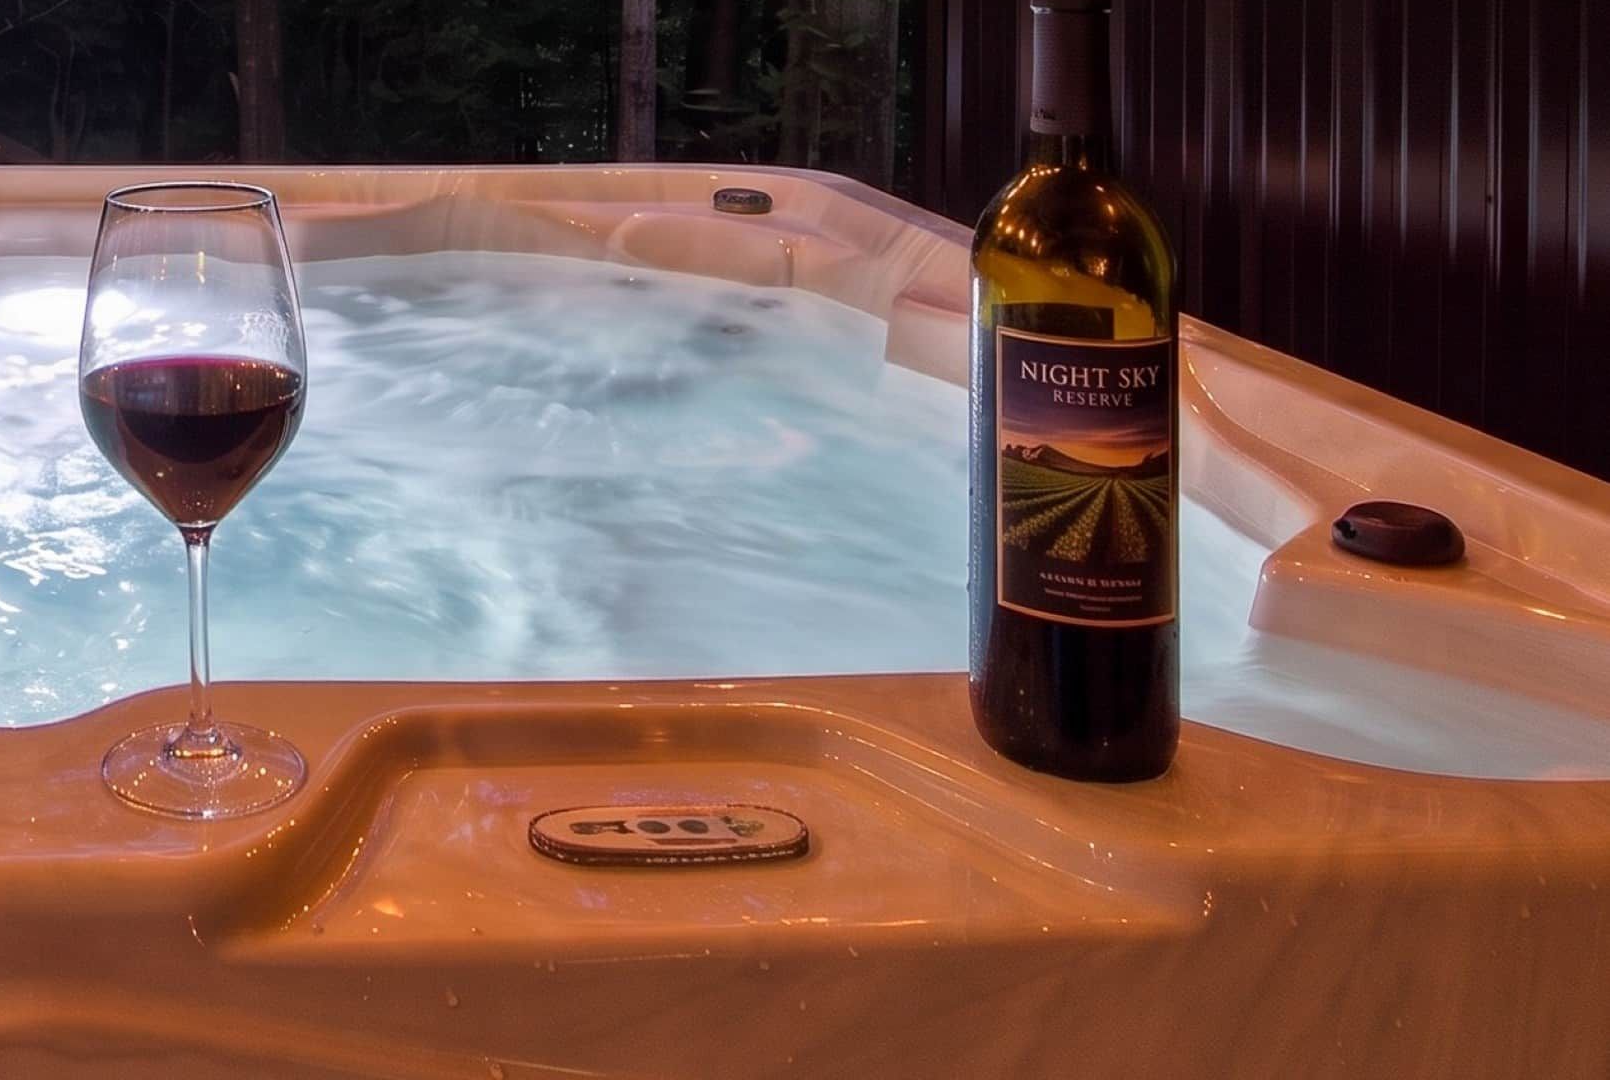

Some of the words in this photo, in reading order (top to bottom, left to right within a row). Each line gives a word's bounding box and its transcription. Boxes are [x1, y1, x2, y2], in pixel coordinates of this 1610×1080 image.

[1020, 360, 1110, 389] NIGHT
[1118, 365, 1160, 389] SKY
[1053, 389, 1133, 407] RESERVE
